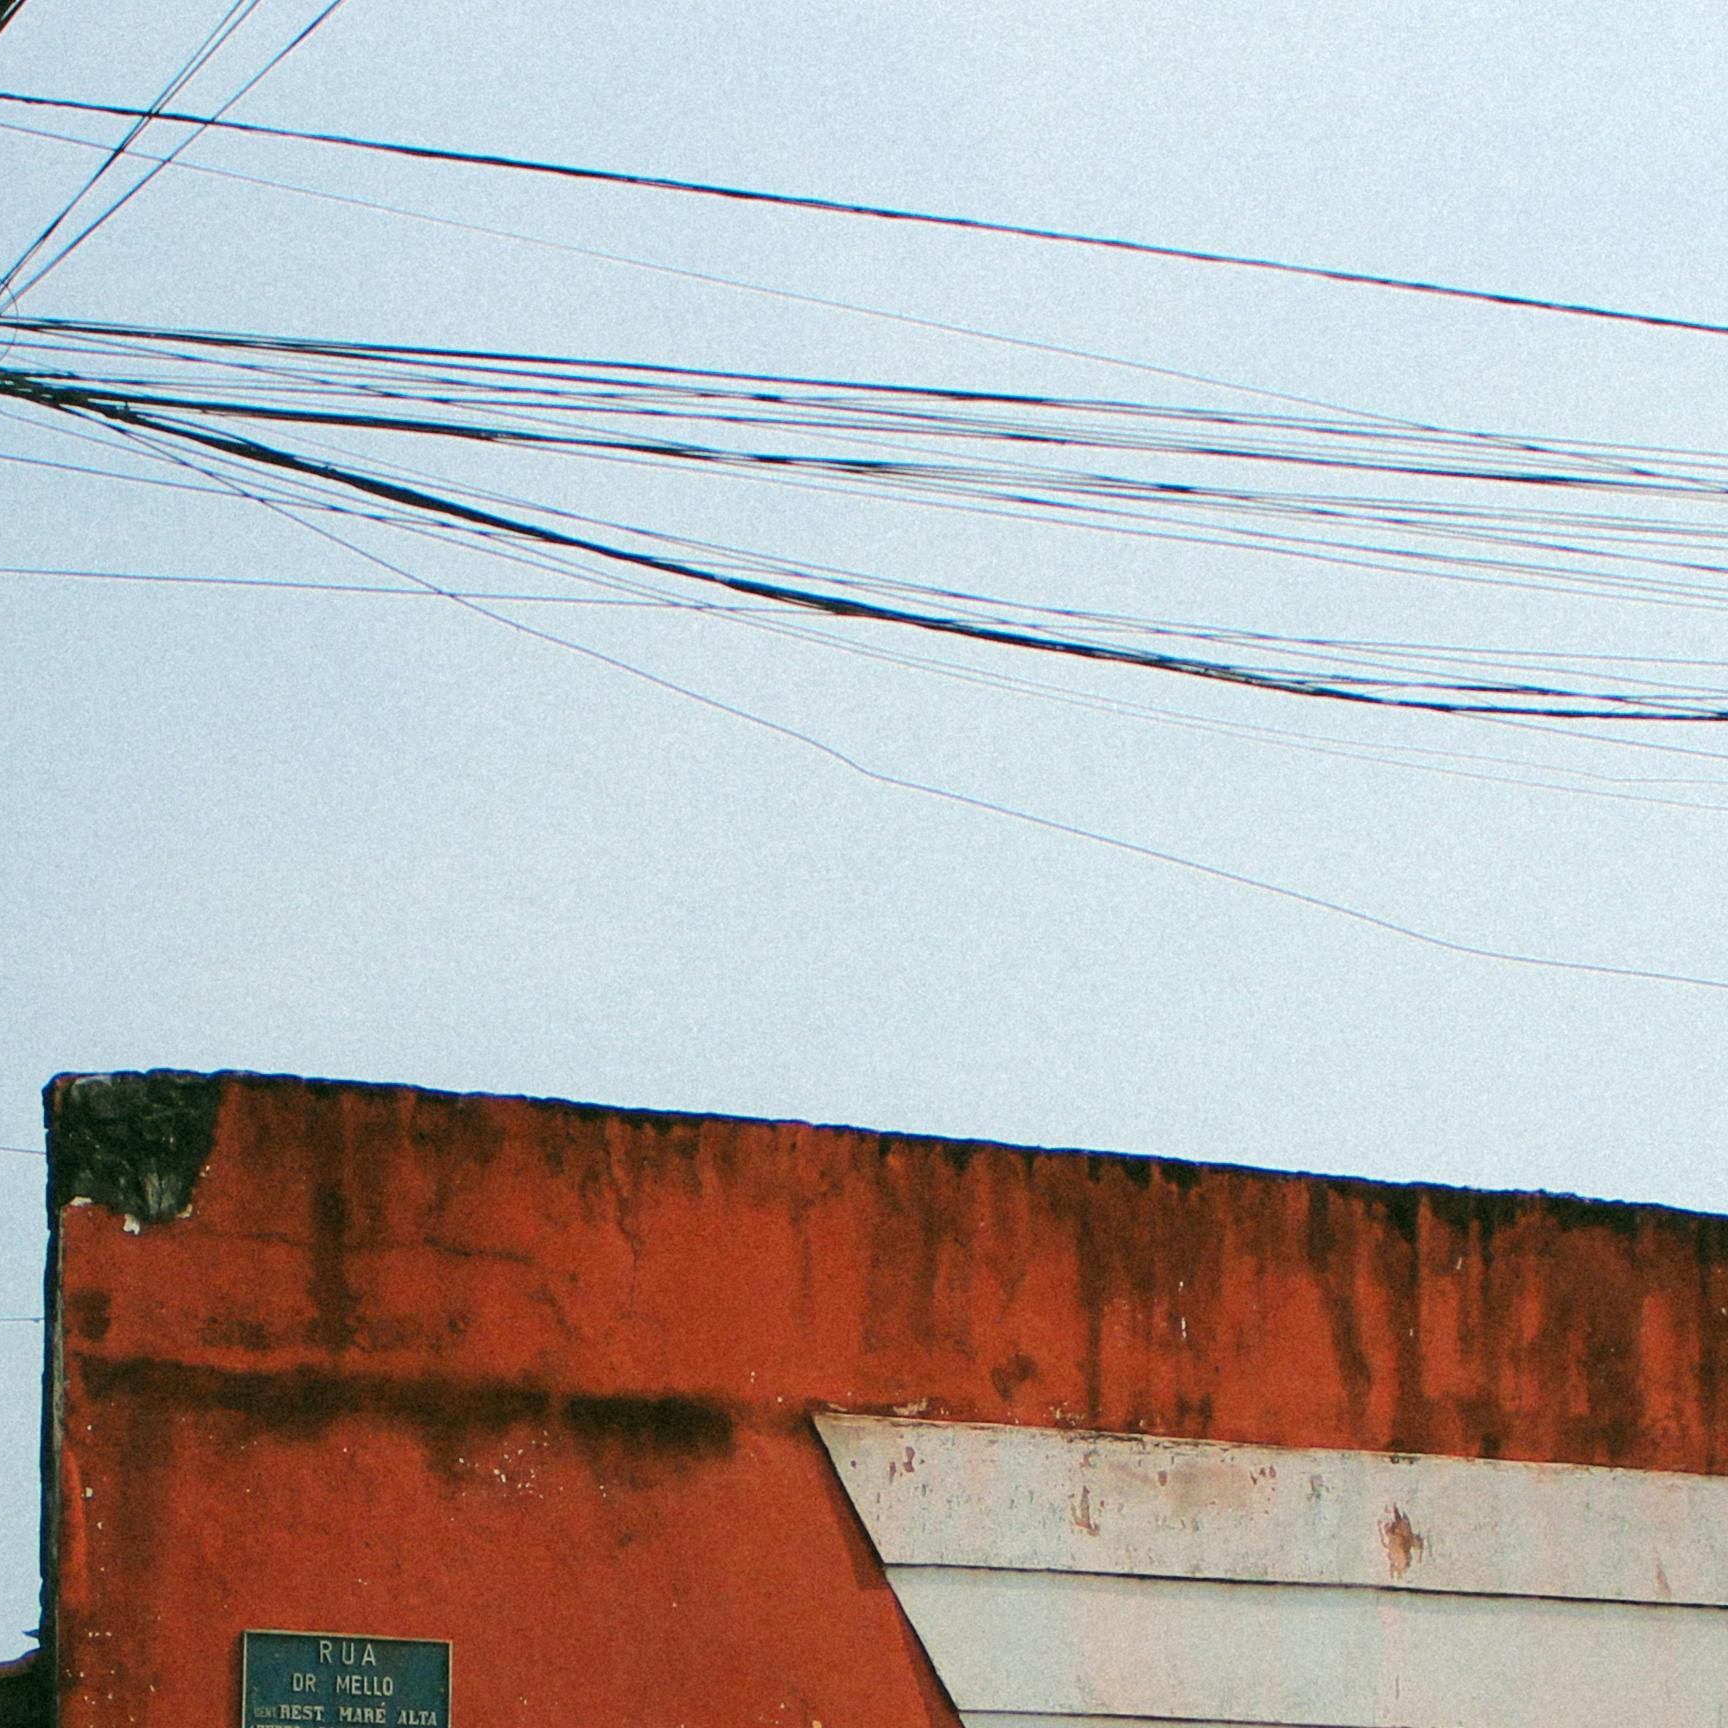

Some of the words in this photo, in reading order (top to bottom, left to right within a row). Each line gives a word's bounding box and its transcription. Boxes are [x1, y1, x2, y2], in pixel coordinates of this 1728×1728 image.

[319, 1639, 376, 1667] RUA
[335, 1675, 394, 1697] MELLO
[338, 1701, 387, 1724] MARÉ
[397, 1709, 438, 1727] ALTA
